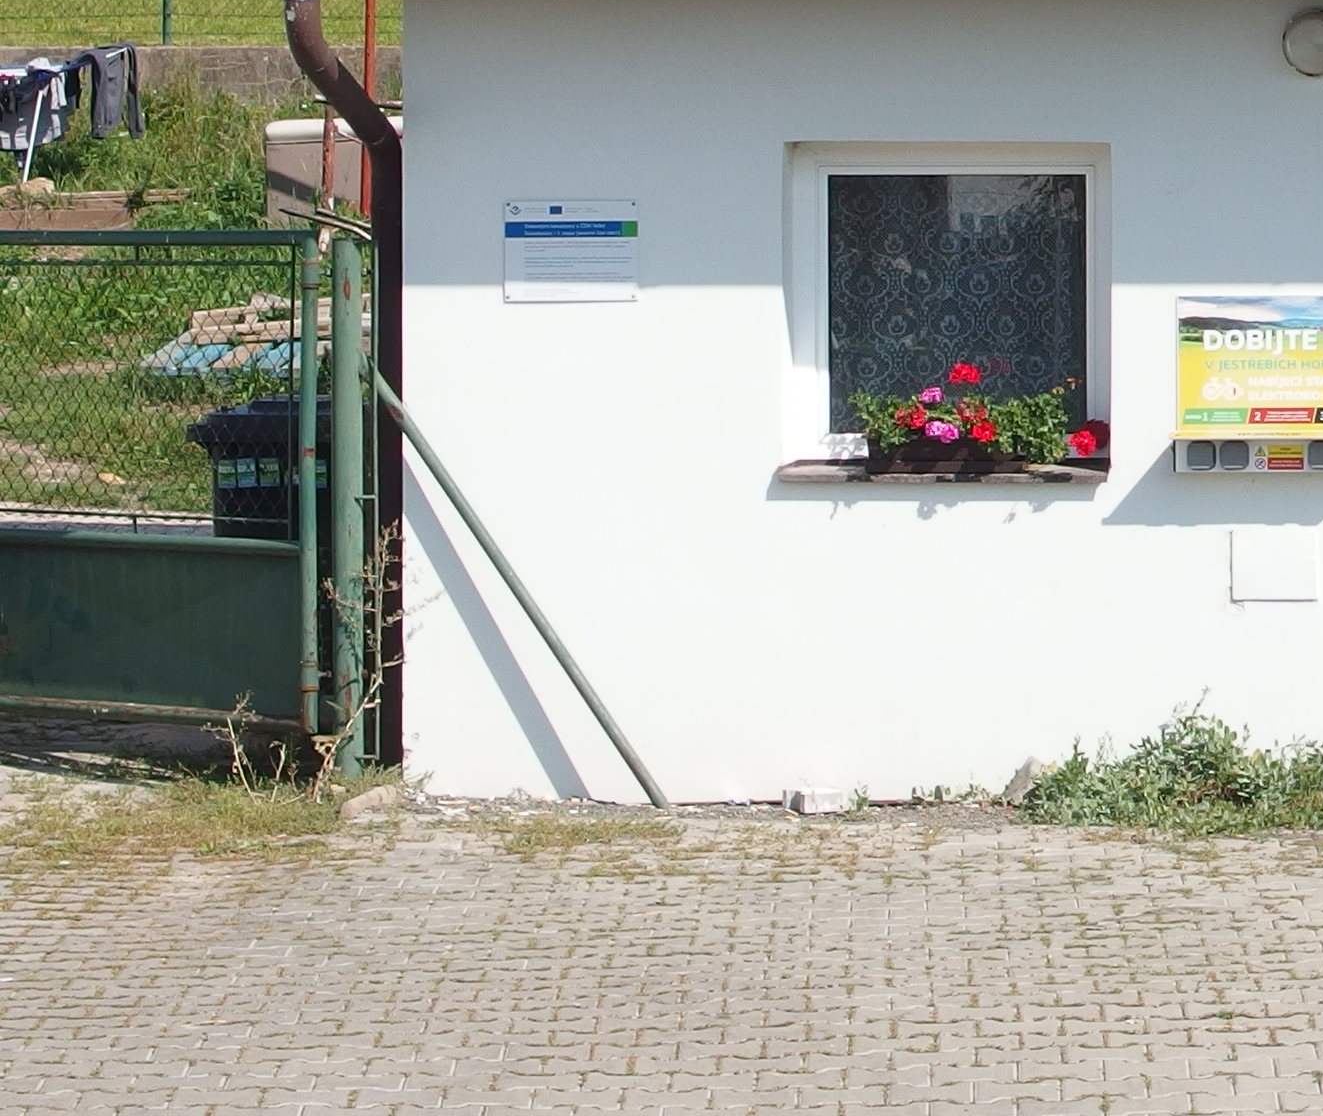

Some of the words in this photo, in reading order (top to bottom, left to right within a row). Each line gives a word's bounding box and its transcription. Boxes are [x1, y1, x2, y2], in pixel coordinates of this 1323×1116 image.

[1203, 330, 1318, 354] DOBIJTE
[1204, 360, 1214, 369] V
[1203, 412, 1208, 421] 1
[1254, 412, 1262, 421] 2
